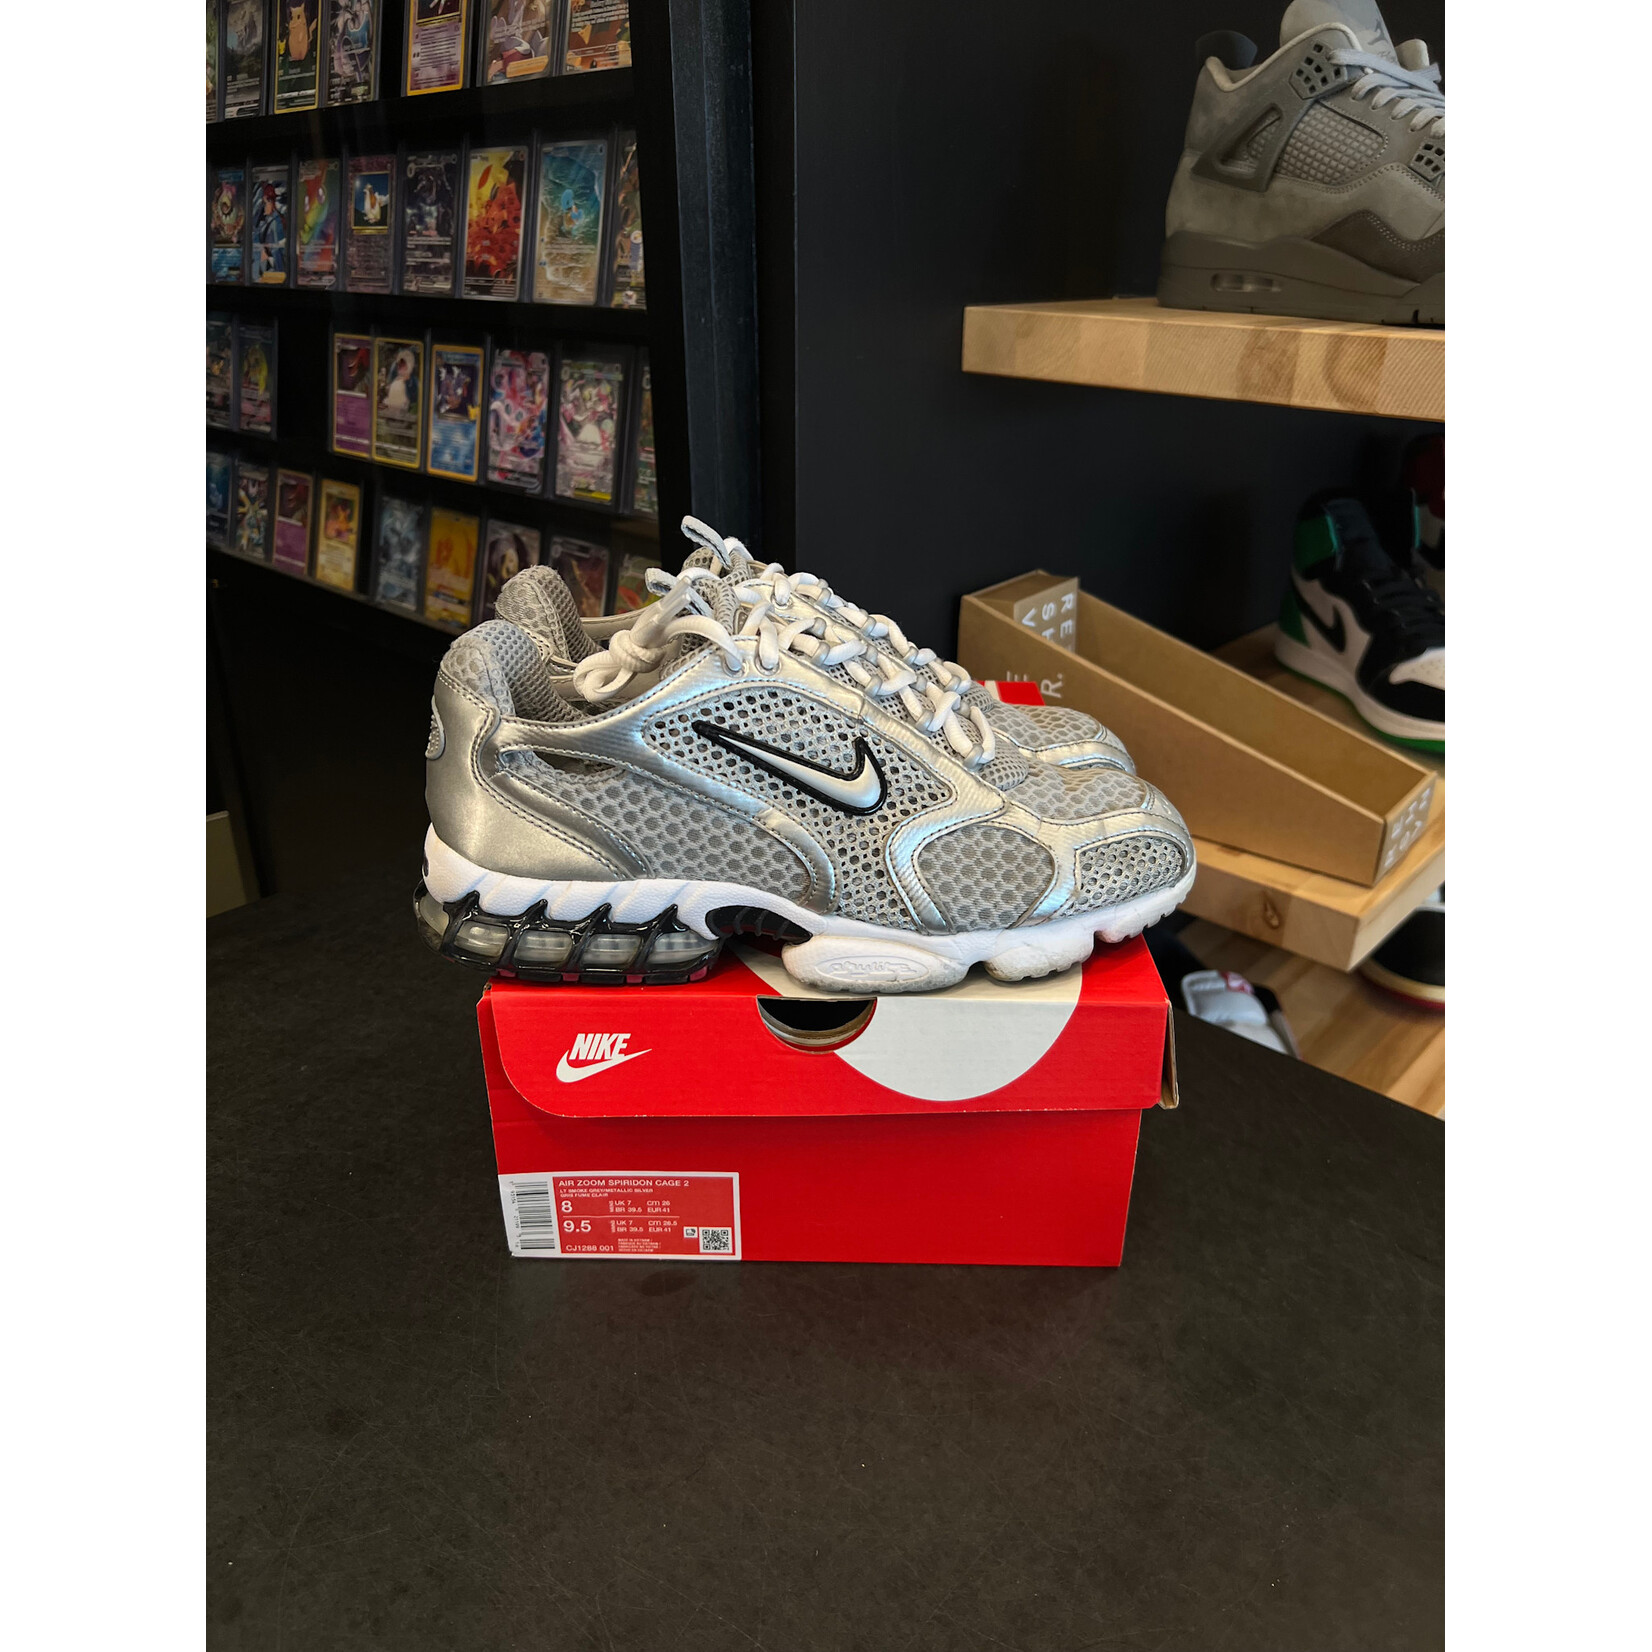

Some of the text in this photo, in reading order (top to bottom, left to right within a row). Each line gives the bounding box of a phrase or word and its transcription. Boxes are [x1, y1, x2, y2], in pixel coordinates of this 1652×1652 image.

[569, 1033, 632, 1060] NIKE
[576, 1179, 606, 1187] ZOOM
[608, 1179, 653, 1187] SPIRIDON
[655, 1179, 681, 1187] CAGE
[561, 1200, 573, 1213] 8
[563, 1220, 592, 1233] 9.5
[565, 1244, 599, 1252] CJ1288
